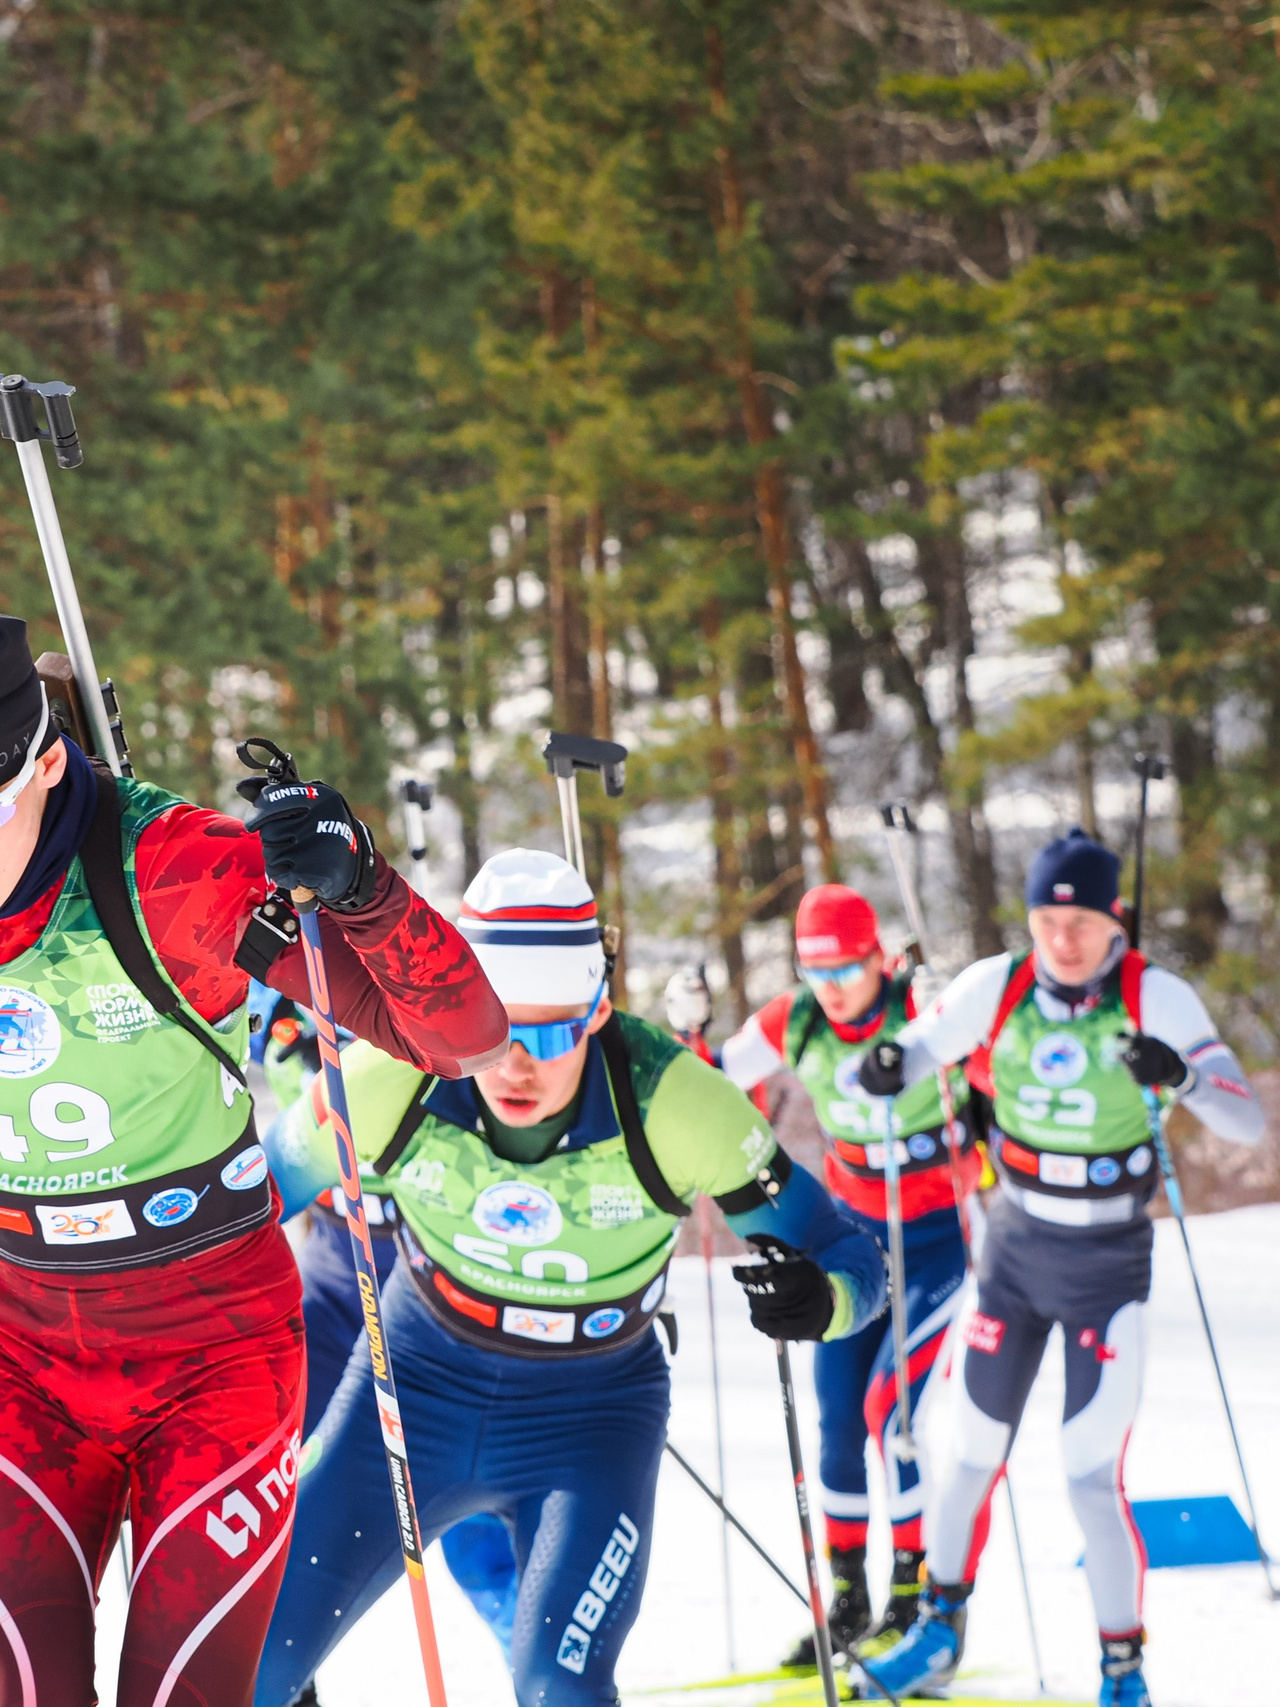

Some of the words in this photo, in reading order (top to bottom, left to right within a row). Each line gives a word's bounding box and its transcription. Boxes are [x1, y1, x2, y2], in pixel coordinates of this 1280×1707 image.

[97, 1033, 132, 1043] ПРОЕКТ
[357, 1271, 388, 1381] CHAMPION
[394, 1483, 412, 1531] CARBON
